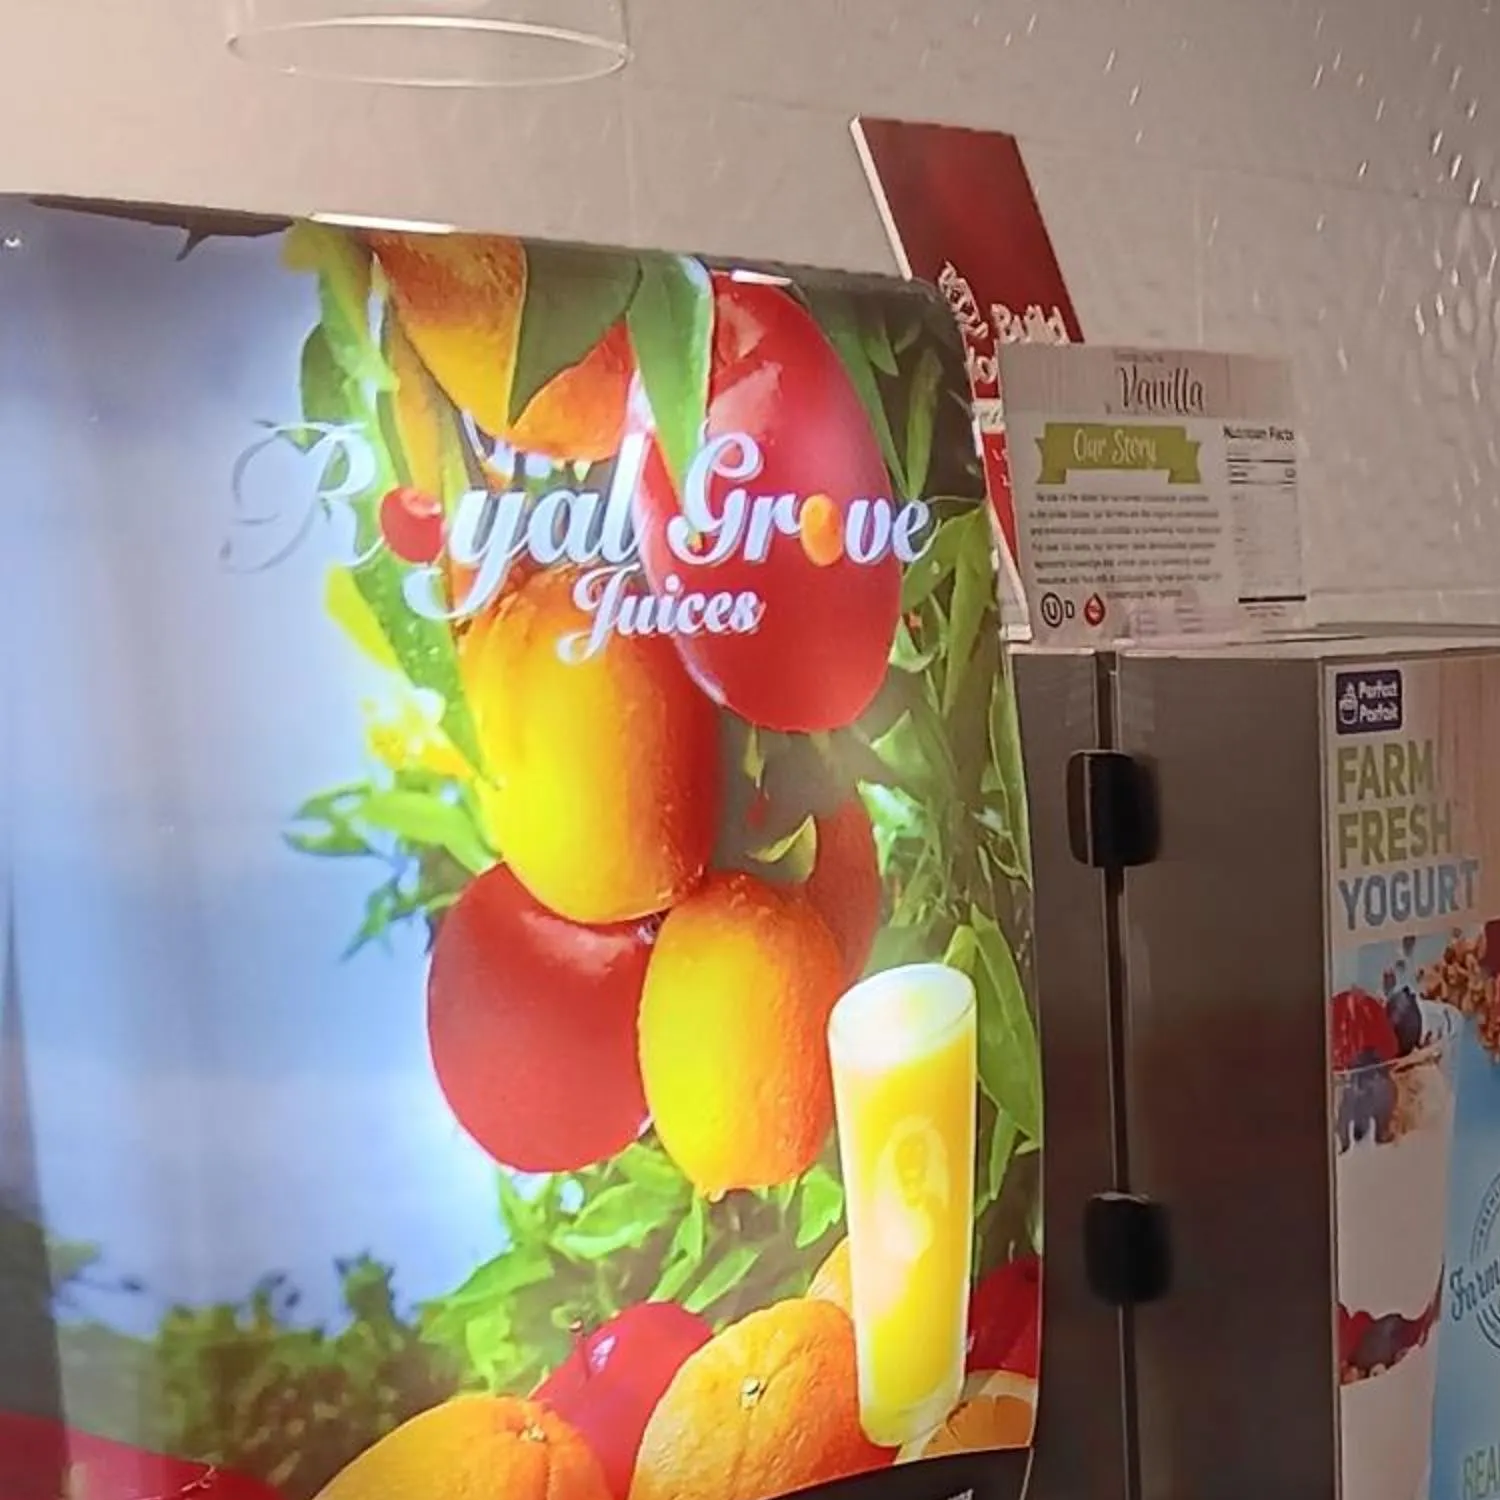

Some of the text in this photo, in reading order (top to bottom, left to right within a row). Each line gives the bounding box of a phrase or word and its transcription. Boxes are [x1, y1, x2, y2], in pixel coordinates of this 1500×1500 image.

[1119, 364, 1204, 414] Vanilla
[1073, 428, 1157, 464] Our Story
[1268, 426, 1295, 442] Facts
[219, 419, 938, 619] Royal Grove
[556, 567, 766, 664] Juices
[1337, 740, 1434, 803] FARM
[1338, 798, 1452, 869] FRESH
[1338, 859, 1479, 931] YOGURT
